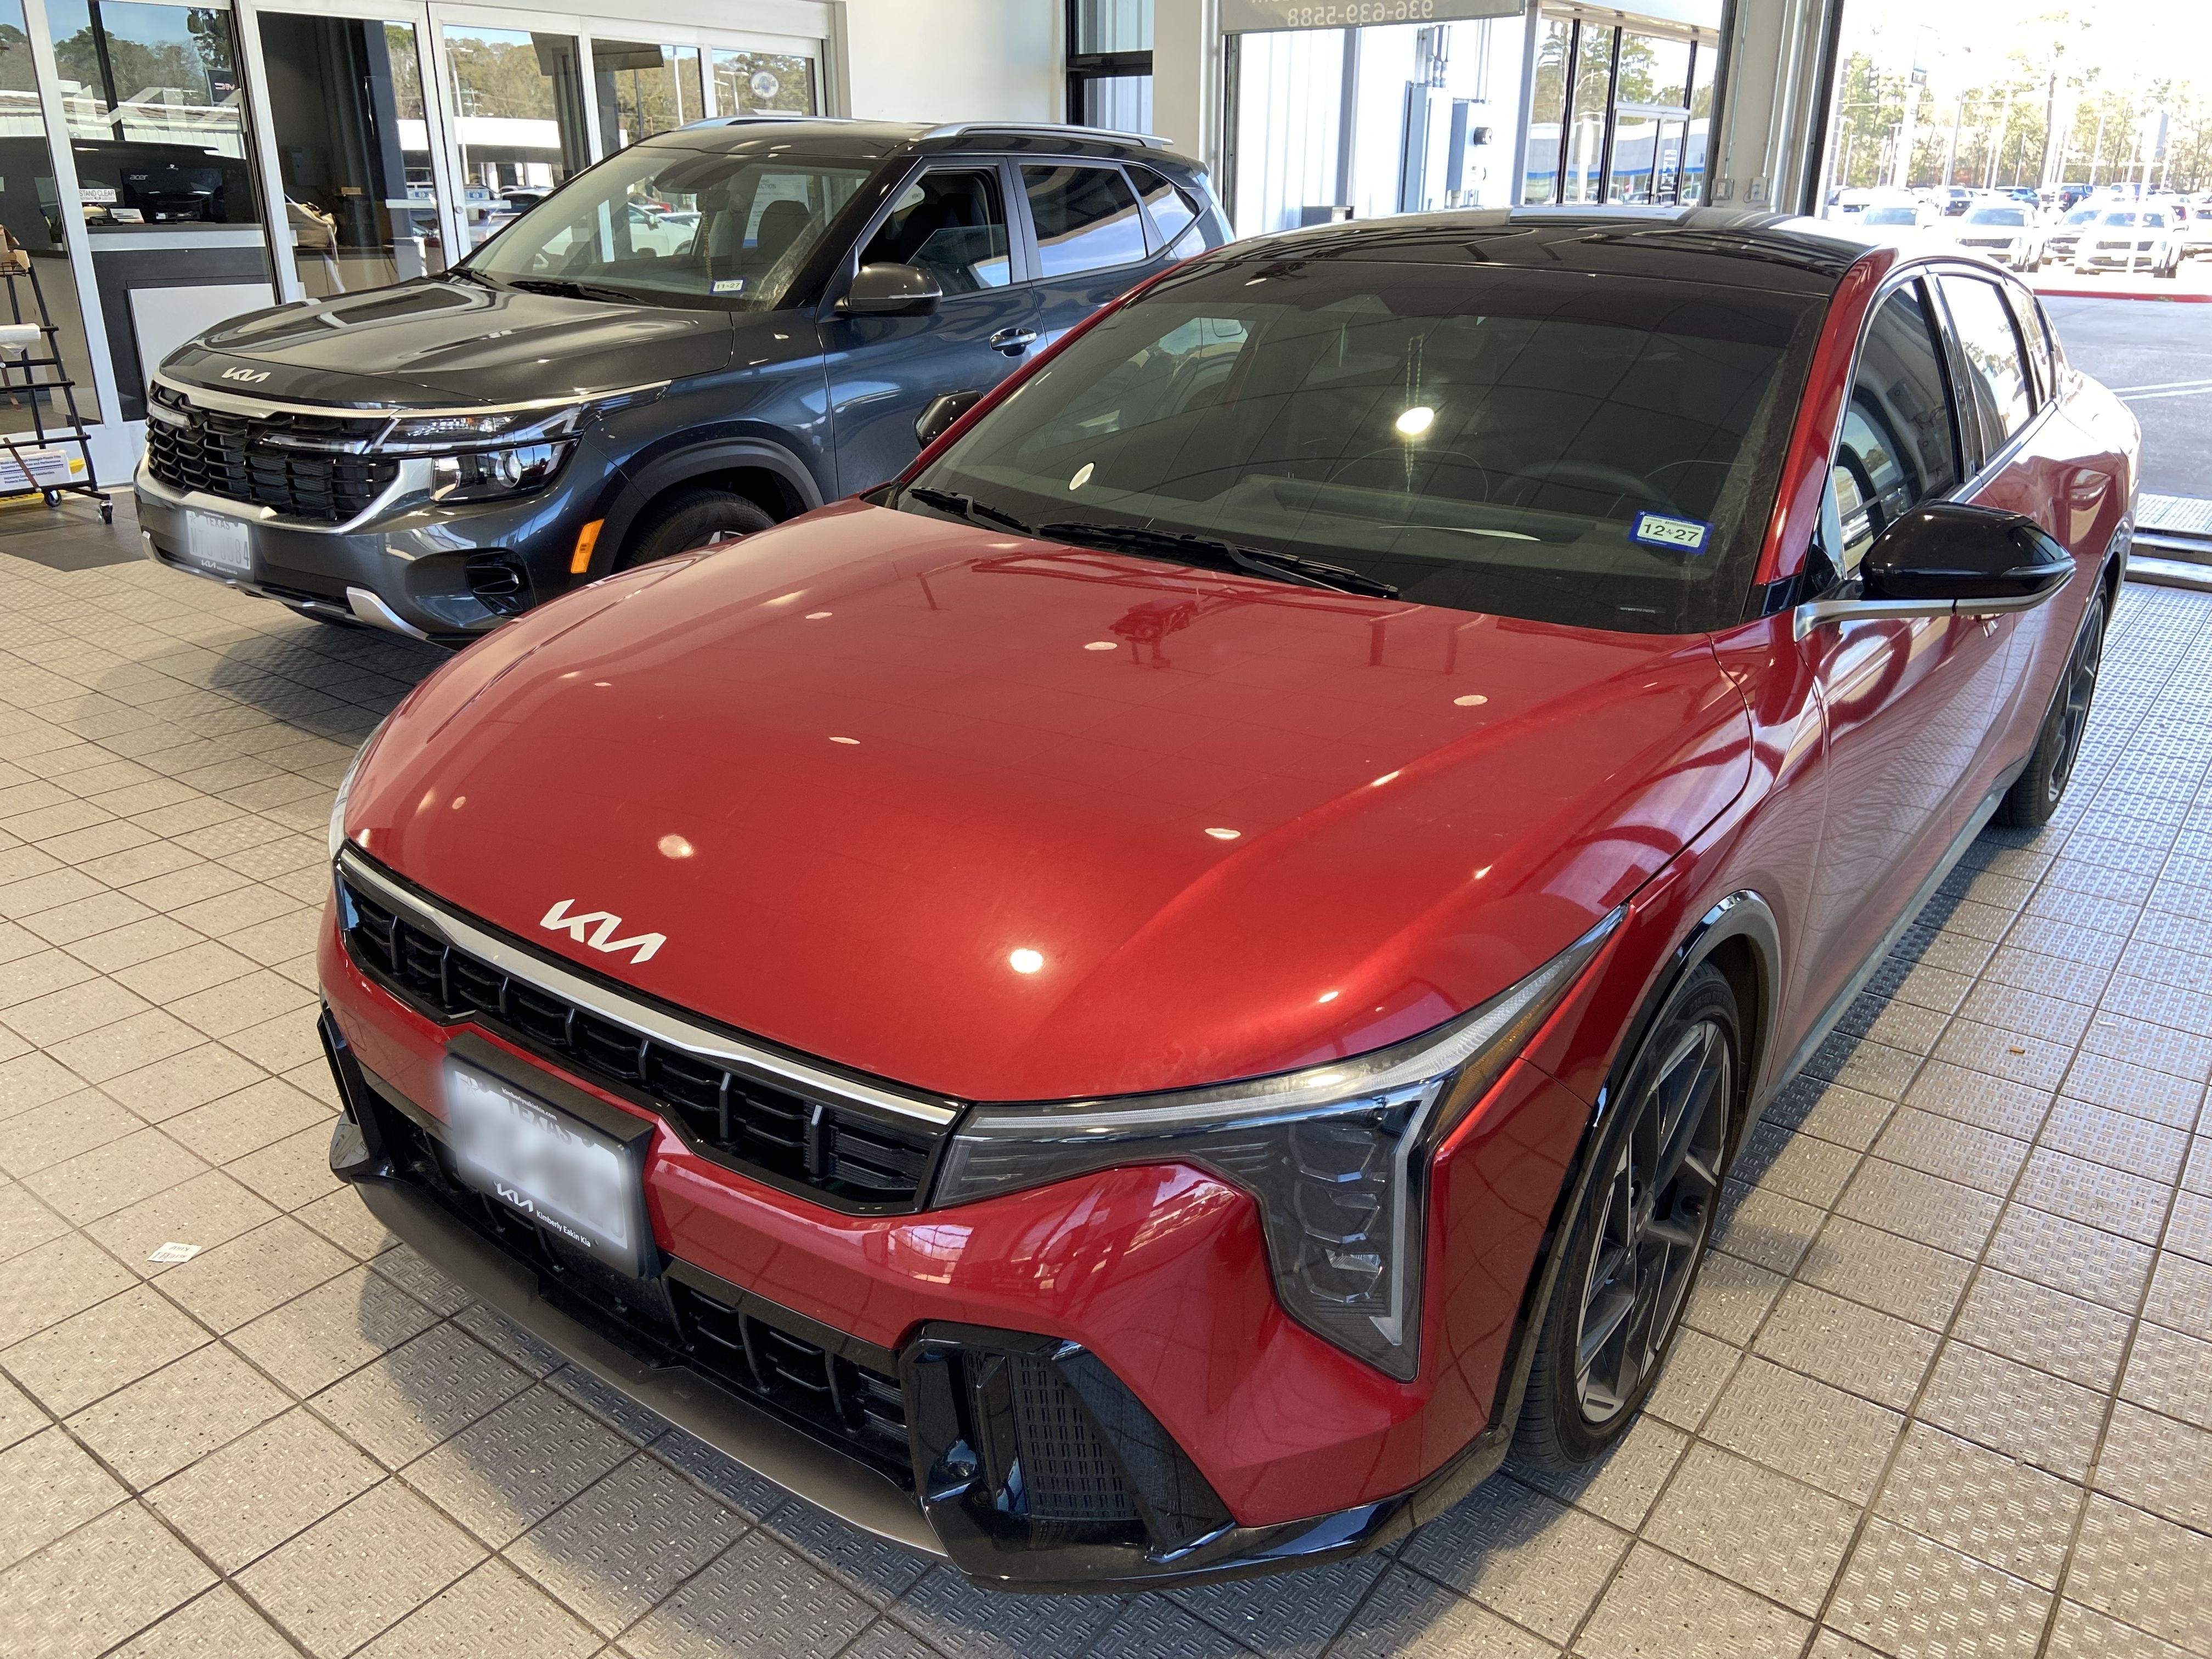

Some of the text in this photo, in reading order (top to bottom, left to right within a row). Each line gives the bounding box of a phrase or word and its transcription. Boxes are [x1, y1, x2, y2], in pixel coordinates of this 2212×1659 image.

[221, 366, 271, 383] KIA
[539, 898, 668, 965] KIA
[496, 1183, 591, 1248] KIA Kimberly Eakin Kia
